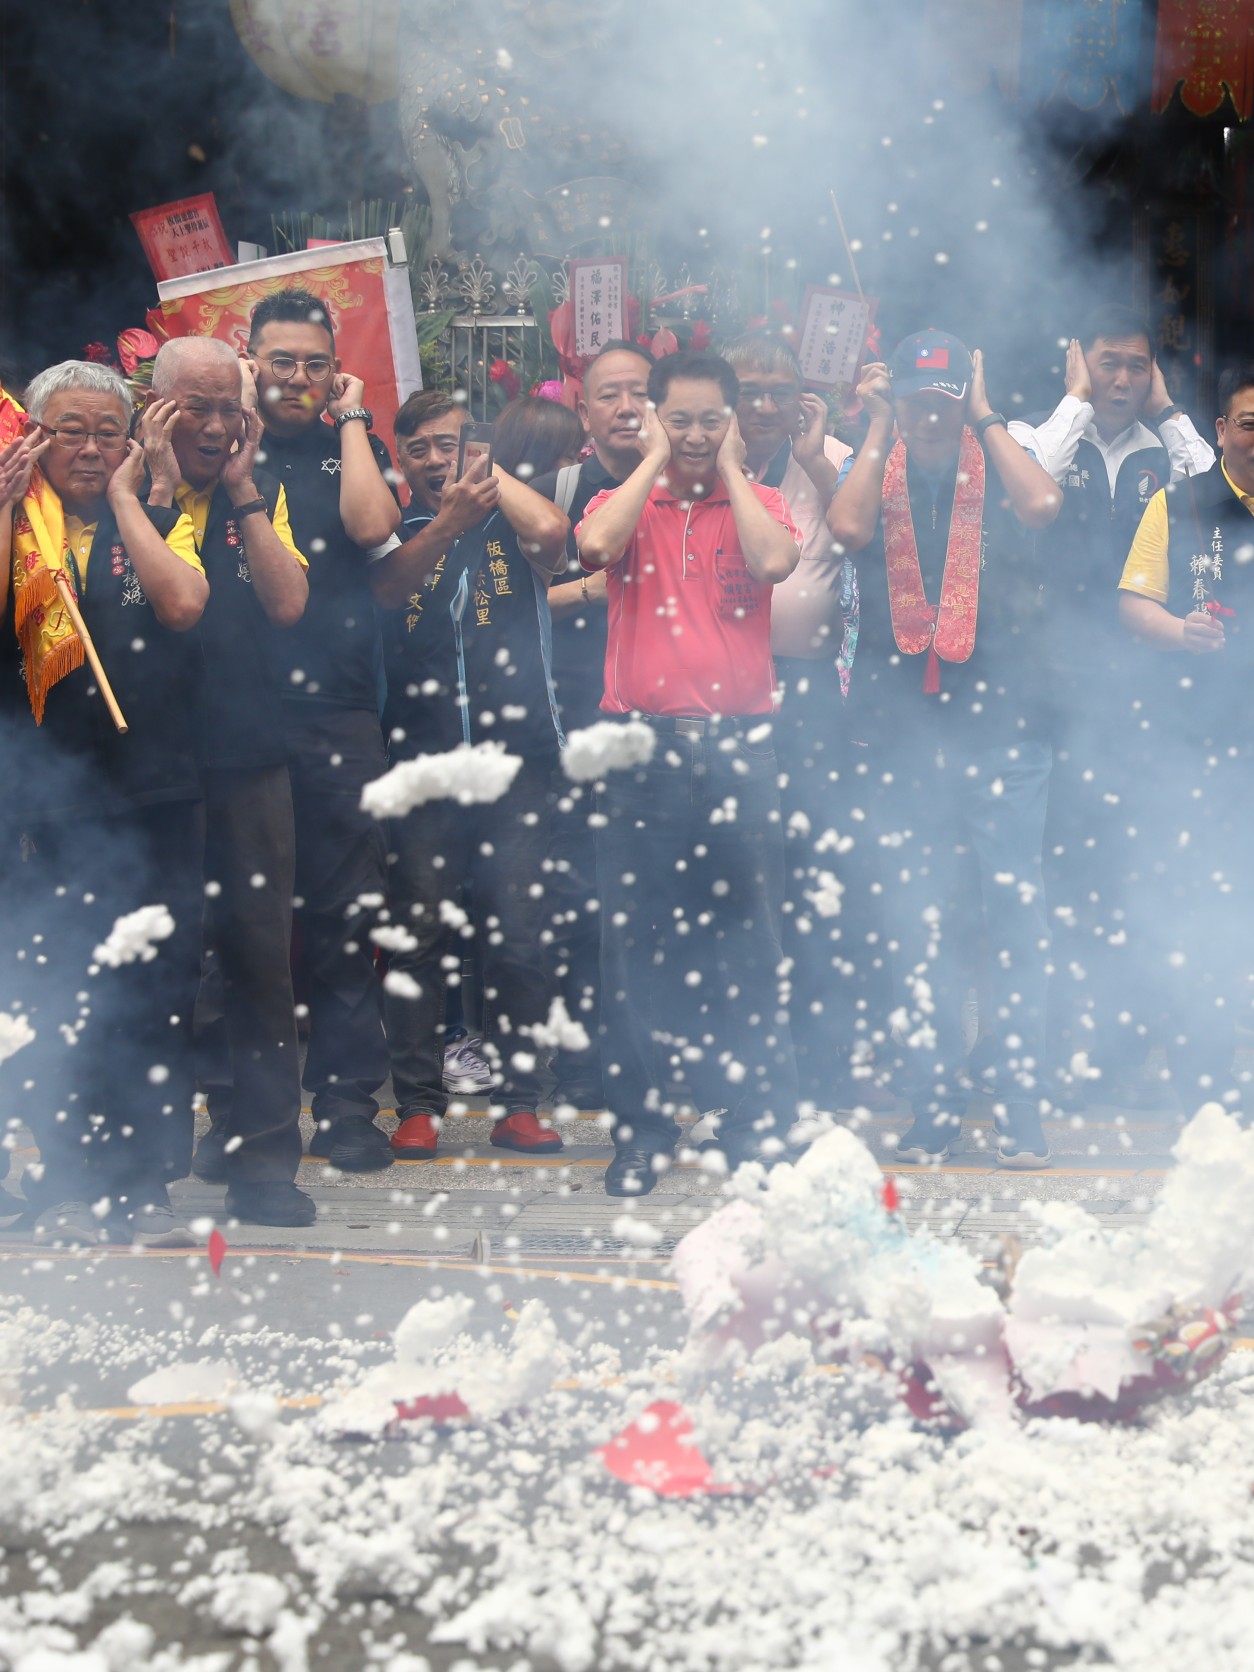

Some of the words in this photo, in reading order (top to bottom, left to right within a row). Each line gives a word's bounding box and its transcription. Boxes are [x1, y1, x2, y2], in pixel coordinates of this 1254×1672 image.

[590, 269, 602, 347] 福澤佑民
[486, 540, 513, 595] 板橋區
[1211, 527, 1224, 581] 主任委員
